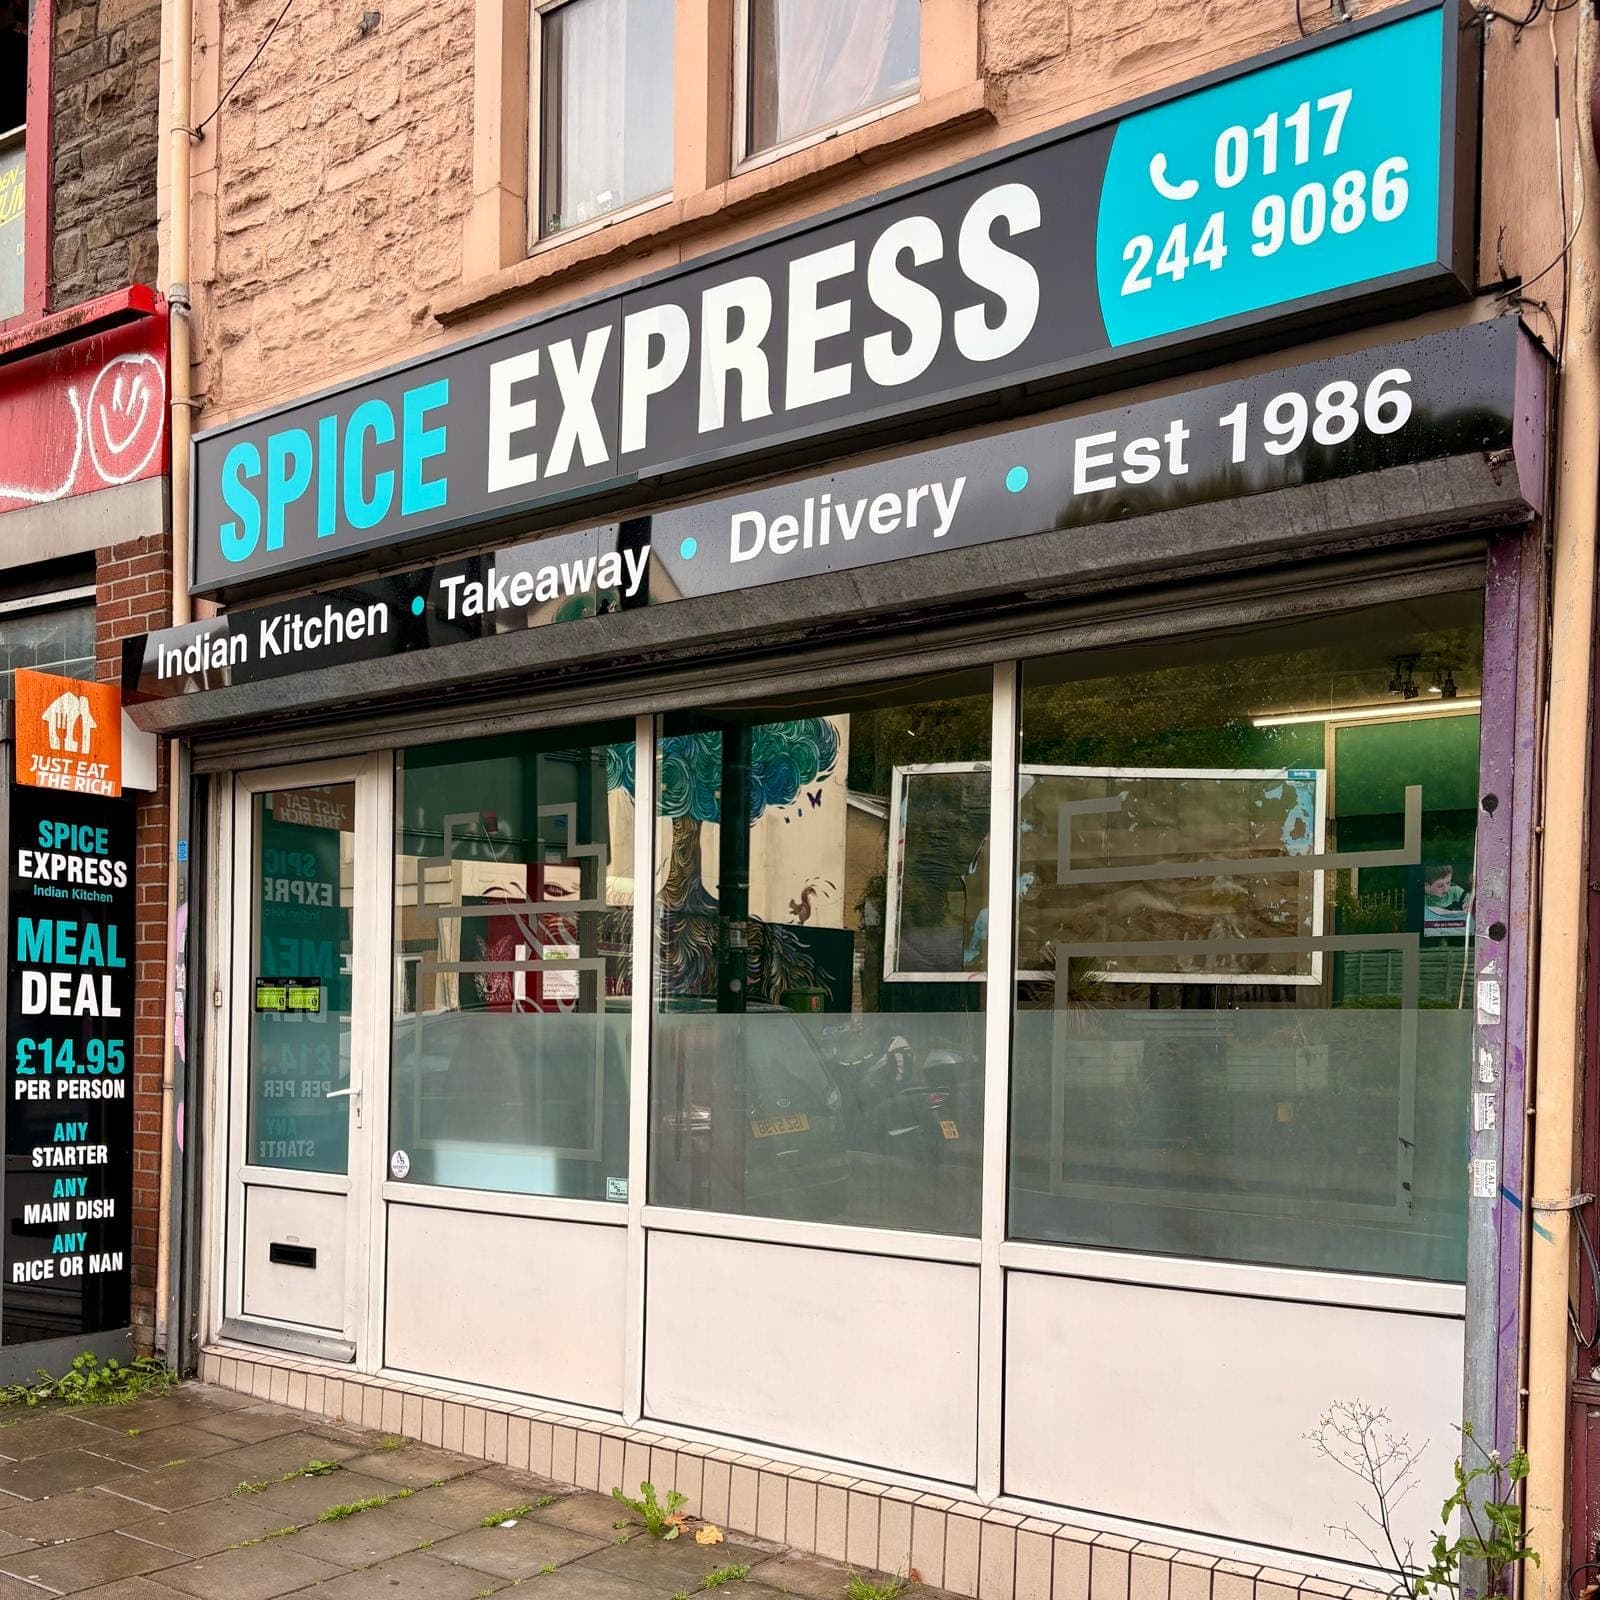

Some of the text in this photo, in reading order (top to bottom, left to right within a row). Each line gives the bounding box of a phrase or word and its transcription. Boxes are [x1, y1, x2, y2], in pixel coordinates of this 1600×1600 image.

[1214, 88, 1353, 189] 0117
[1120, 155, 1410, 297] 244 9086
[219, 182, 1041, 563] SPICE EXPRESS
[157, 367, 1413, 680] Indian Kitchen Takeaway Delivery Est 1986
[30, 754, 110, 779] JUST EAT
[37, 771, 114, 796] THE RICH
[38, 820, 108, 855] SPICE
[18, 849, 127, 888] EXPRESS
[33, 884, 113, 903] Indian Kitchen
[17, 916, 126, 969] MEAL
[21, 970, 121, 1017] DEAL
[15, 1037, 125, 1075] £14.95
[15, 1079, 125, 1100] PER PERSON
[53, 1122, 88, 1142] ANY
[31, 1144, 108, 1168] STARTER
[52, 1177, 88, 1198] ANY
[24, 1199, 115, 1225] MAIN DISH
[52, 1232, 87, 1254] ANY
[12, 1251, 123, 1283] RICE OR NAN
